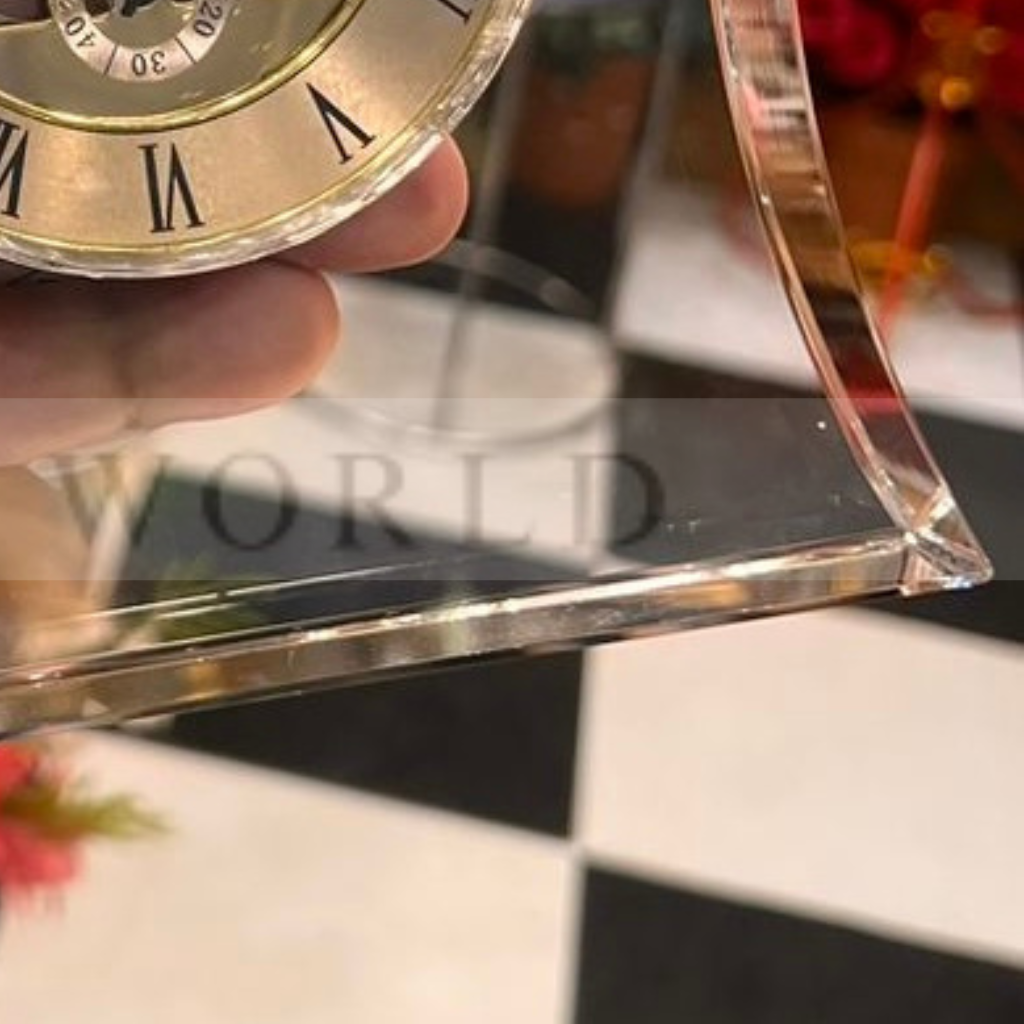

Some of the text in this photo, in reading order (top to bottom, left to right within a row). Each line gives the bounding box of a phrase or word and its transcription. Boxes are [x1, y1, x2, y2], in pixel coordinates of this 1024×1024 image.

[65, 16, 95, 49] 40
[193, 0, 223, 38] 20
[131, 50, 166, 76] 30
[307, 83, 377, 164] V
[139, 142, 204, 234] VI
